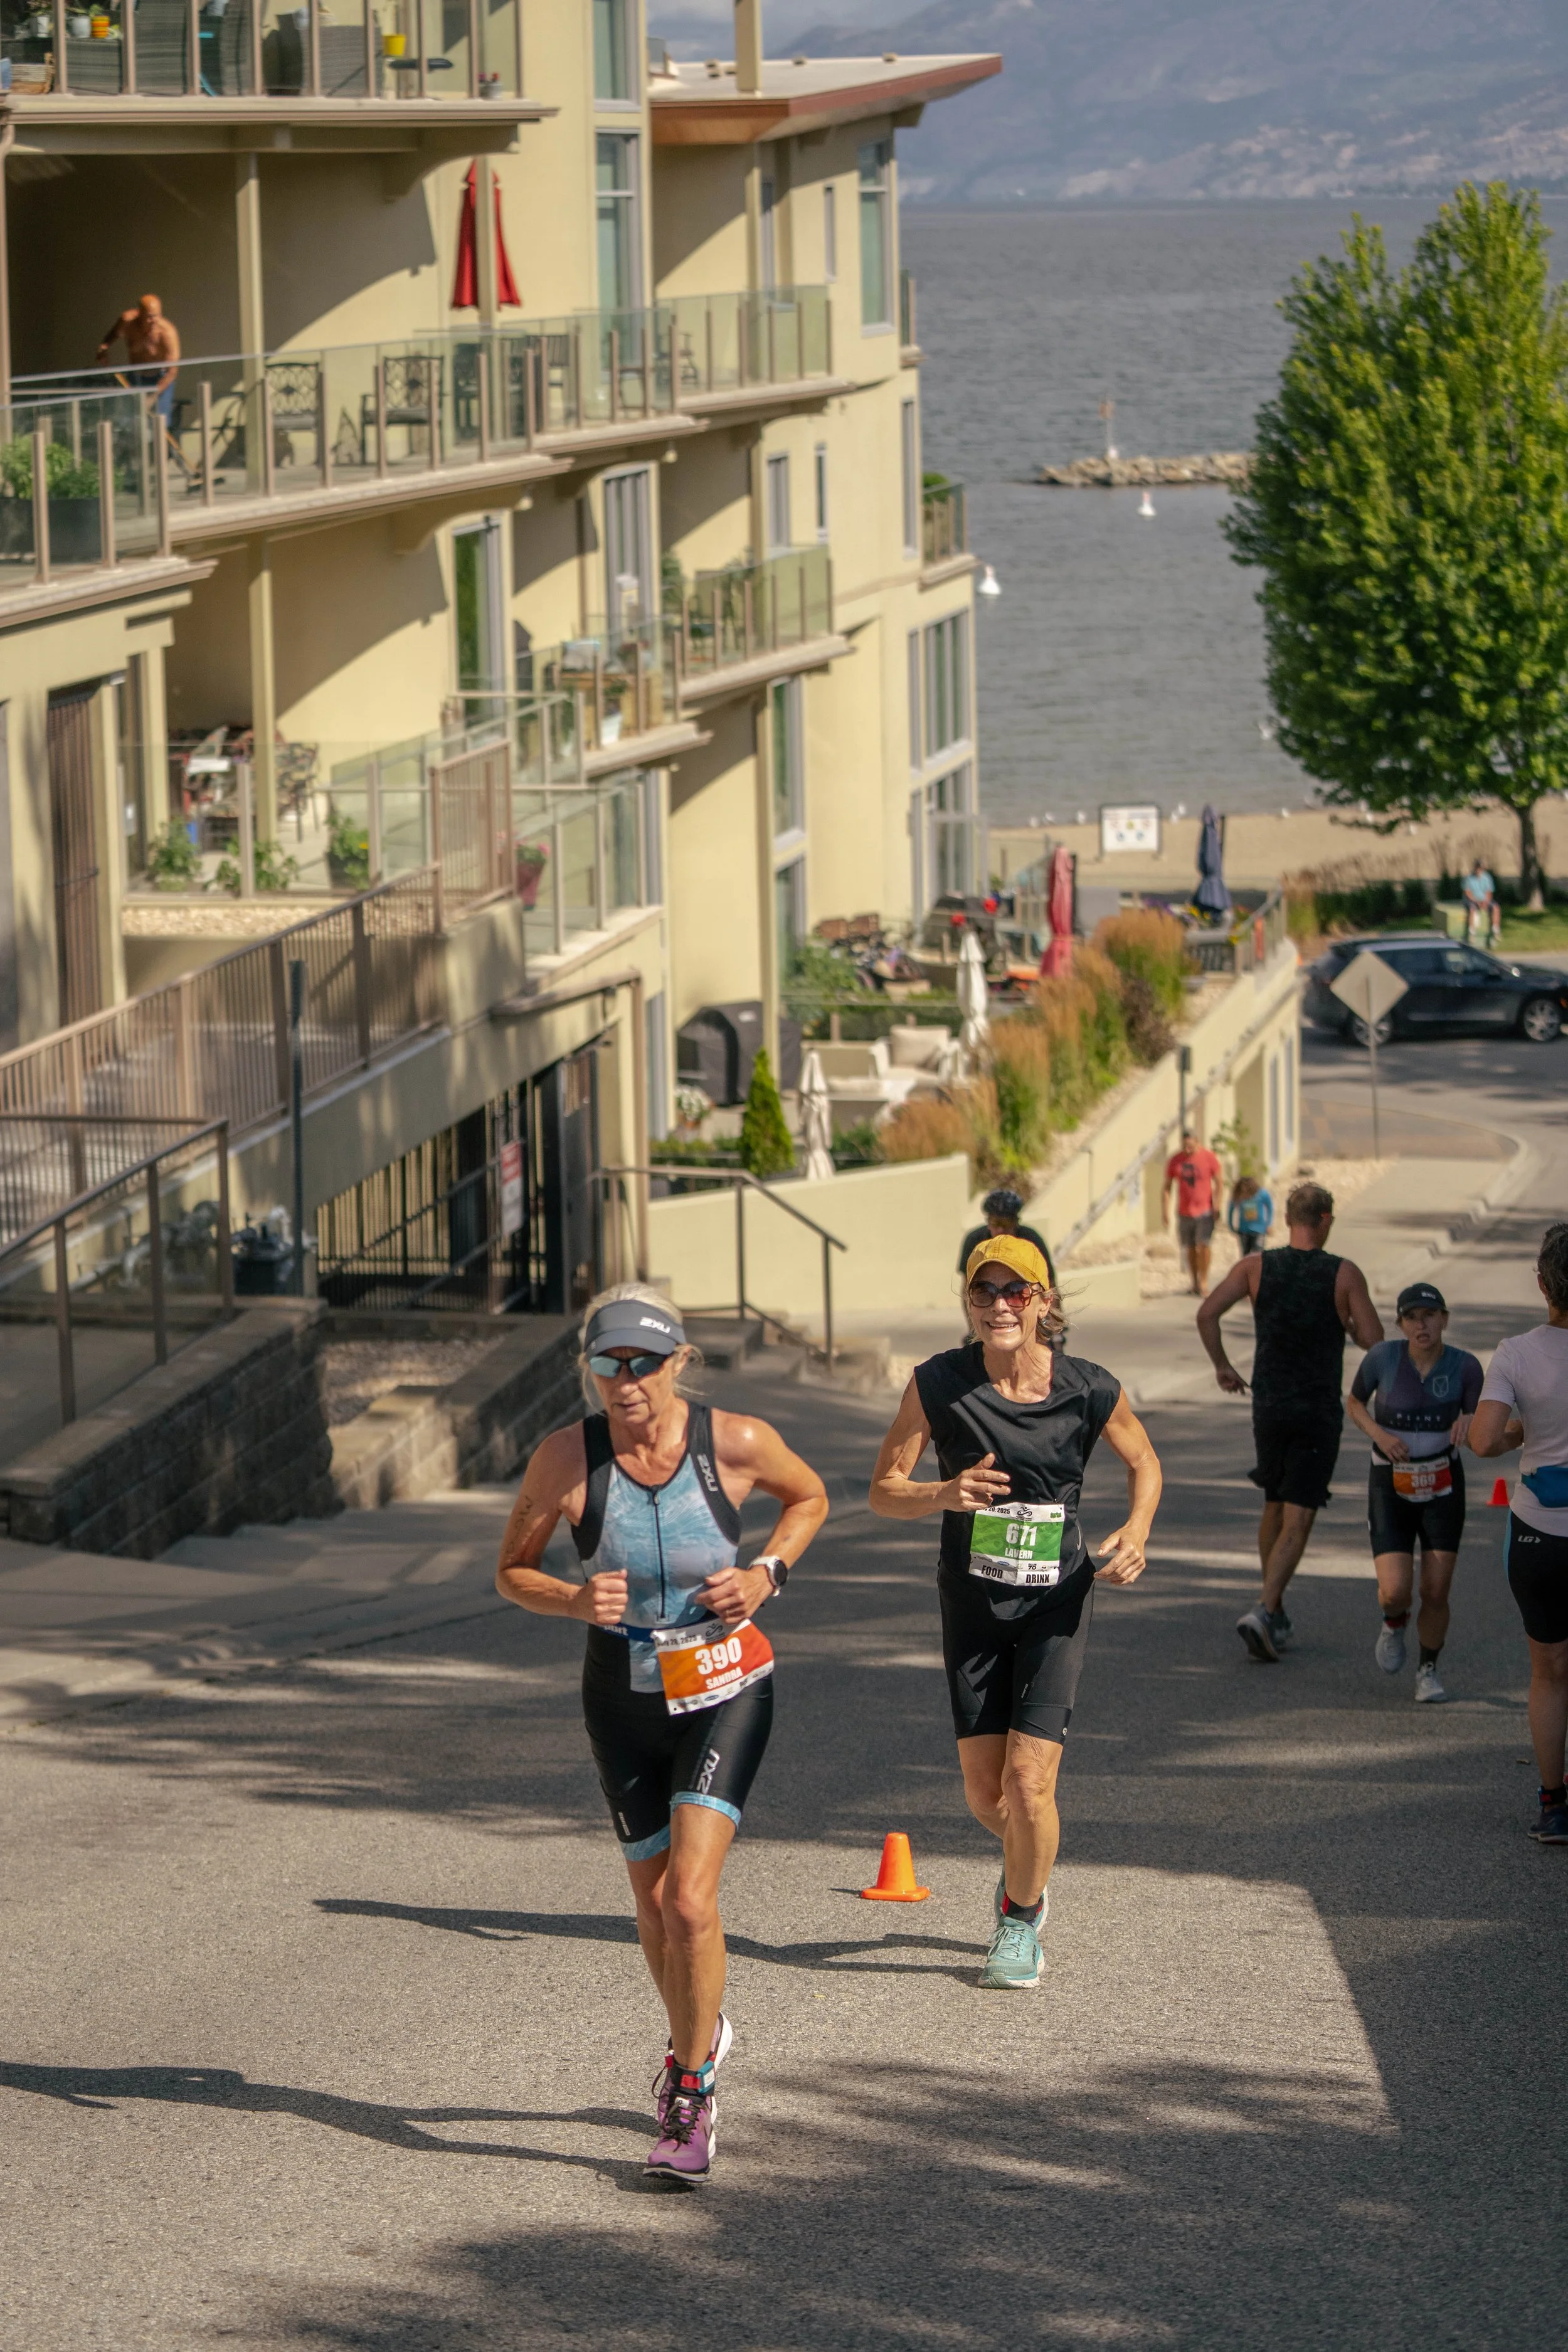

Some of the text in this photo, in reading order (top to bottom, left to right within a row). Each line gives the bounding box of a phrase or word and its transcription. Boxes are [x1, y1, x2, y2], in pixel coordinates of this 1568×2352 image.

[640, 1316, 670, 1333] 2XU
[696, 1453, 719, 1491] 2XU
[1005, 1523, 1038, 1547] 671
[1004, 1547, 1034, 1559] LAVERN
[981, 1564, 1004, 1579] FOOD
[1025, 1574, 1050, 1584] DRINK
[694, 1637, 743, 1675] 390
[706, 1666, 744, 1690] SANDRA
[696, 1748, 720, 1794] 2XU
